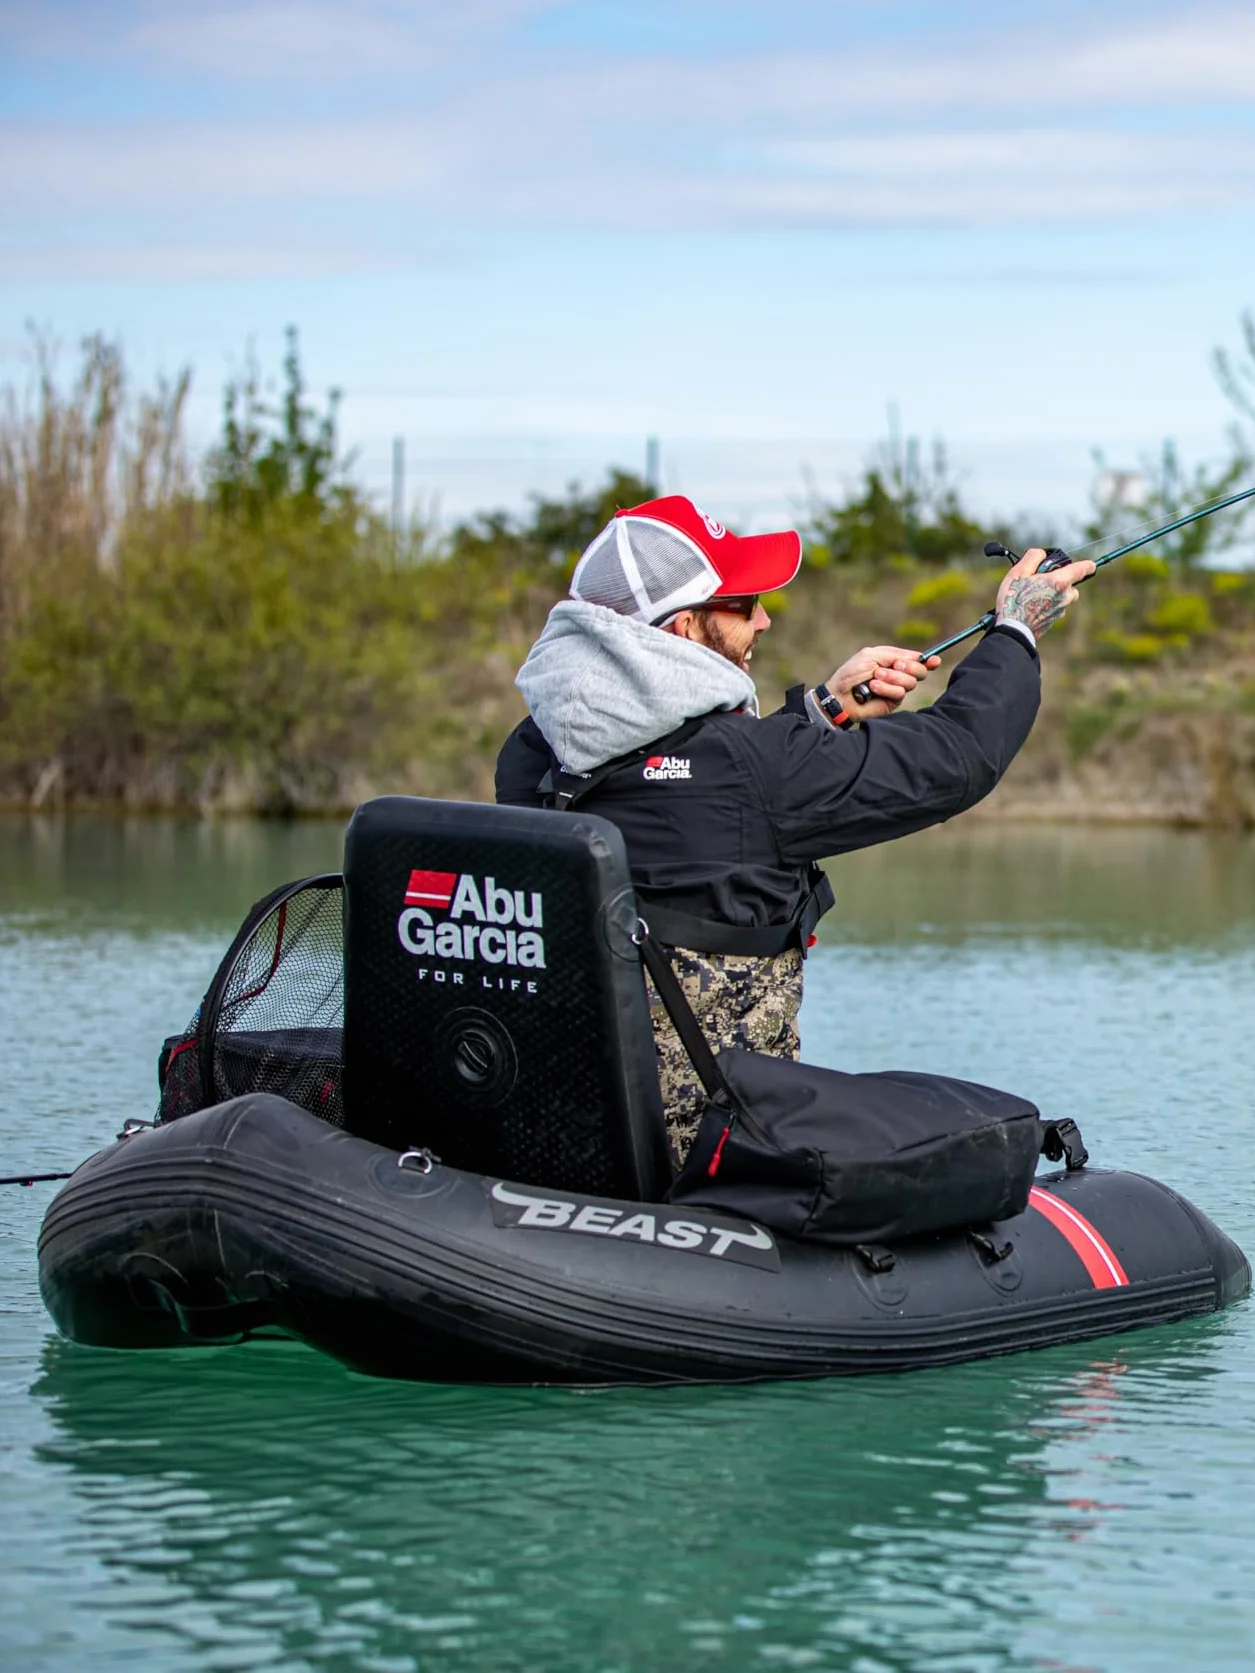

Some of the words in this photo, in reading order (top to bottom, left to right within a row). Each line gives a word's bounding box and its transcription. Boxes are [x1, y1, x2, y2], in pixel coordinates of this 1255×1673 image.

[660, 756, 690, 770] Abu
[450, 873, 543, 928] Abu
[398, 907, 547, 969] Garcia
[418, 968, 464, 985] FOR
[482, 975, 538, 993] LIFE
[491, 1182, 773, 1257] BEAST
